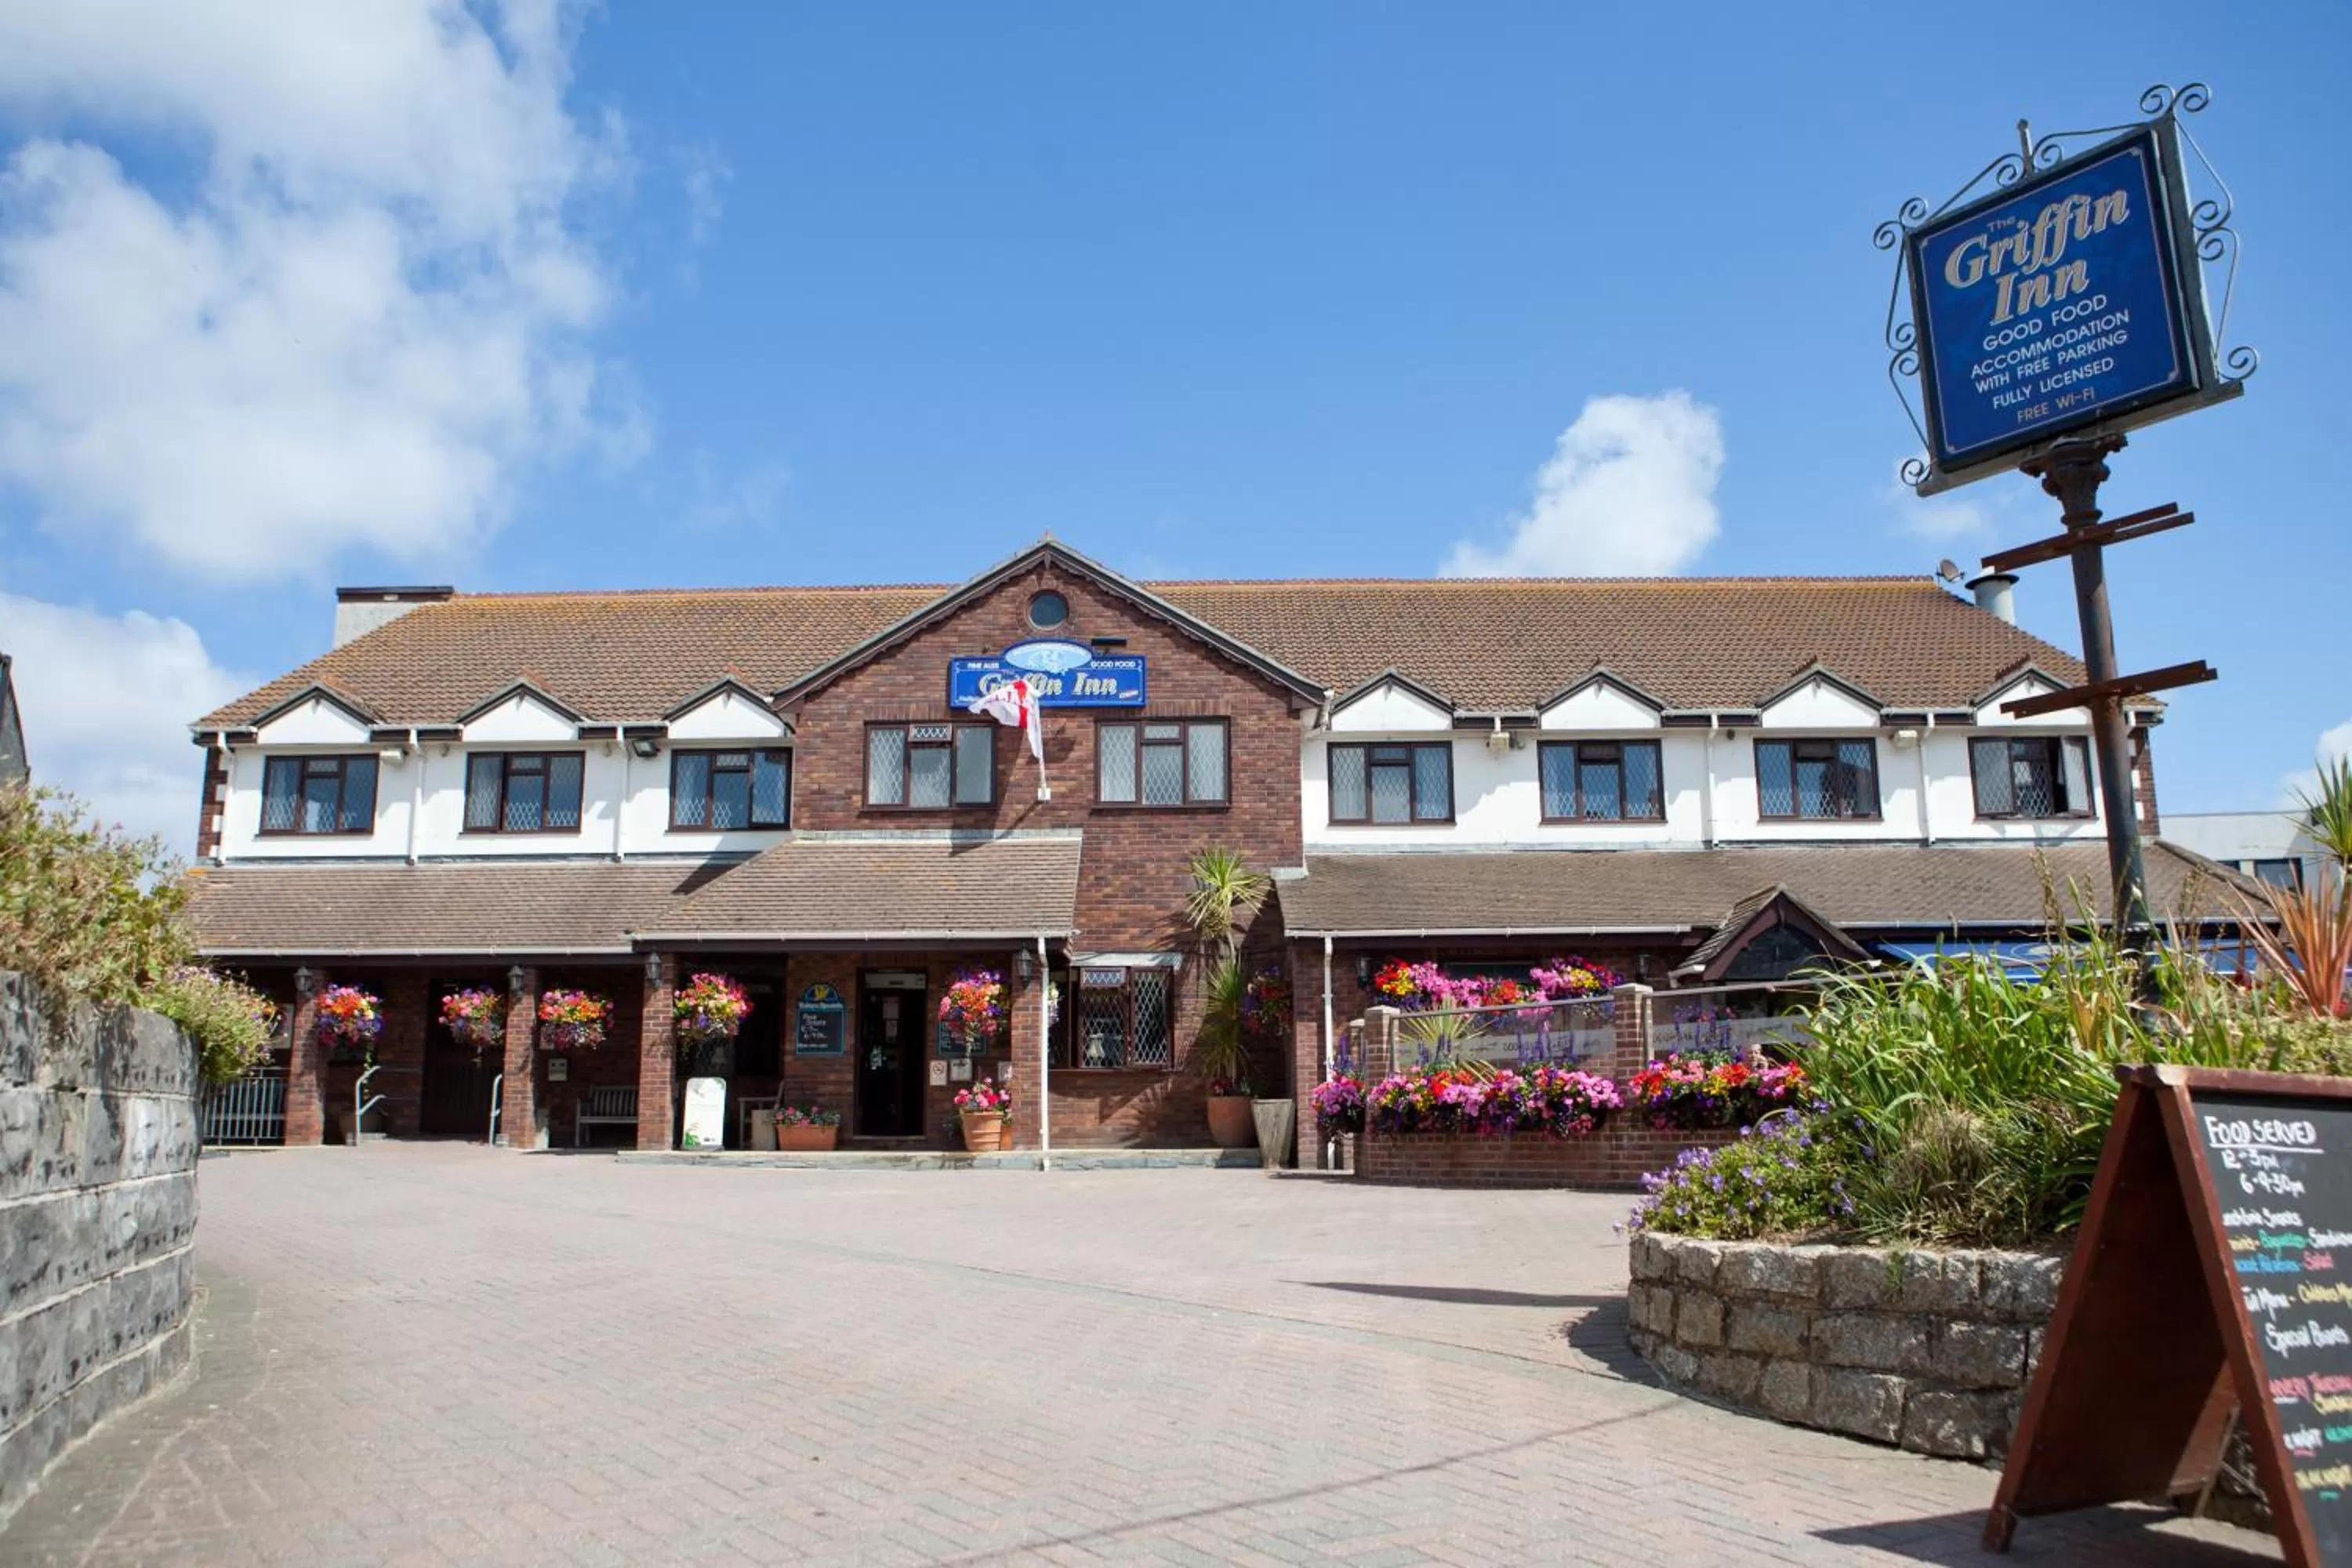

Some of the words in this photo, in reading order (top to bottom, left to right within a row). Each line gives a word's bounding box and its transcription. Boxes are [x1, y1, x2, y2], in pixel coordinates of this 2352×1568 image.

[1944, 190, 2130, 289] Griffin
[1989, 260, 2089, 326] Inn
[1971, 309, 2129, 379] ACCOMMODATION
[1983, 319, 2042, 350] GOOD
[2051, 295, 2107, 326] FOOD
[1976, 372, 2010, 394] WITH
[2017, 358, 2050, 380] FREE
[2057, 330, 2128, 365] PARKING
[1993, 384, 2032, 409] FULLY
[2039, 358, 2114, 393] LICENSED
[2017, 402, 2049, 423] FREE
[2056, 387, 2095, 408] WI-FI
[979, 672, 1062, 696] Gfin
[1071, 672, 1117, 695] Inn
[2252, 1119, 2318, 1145] SERVED
